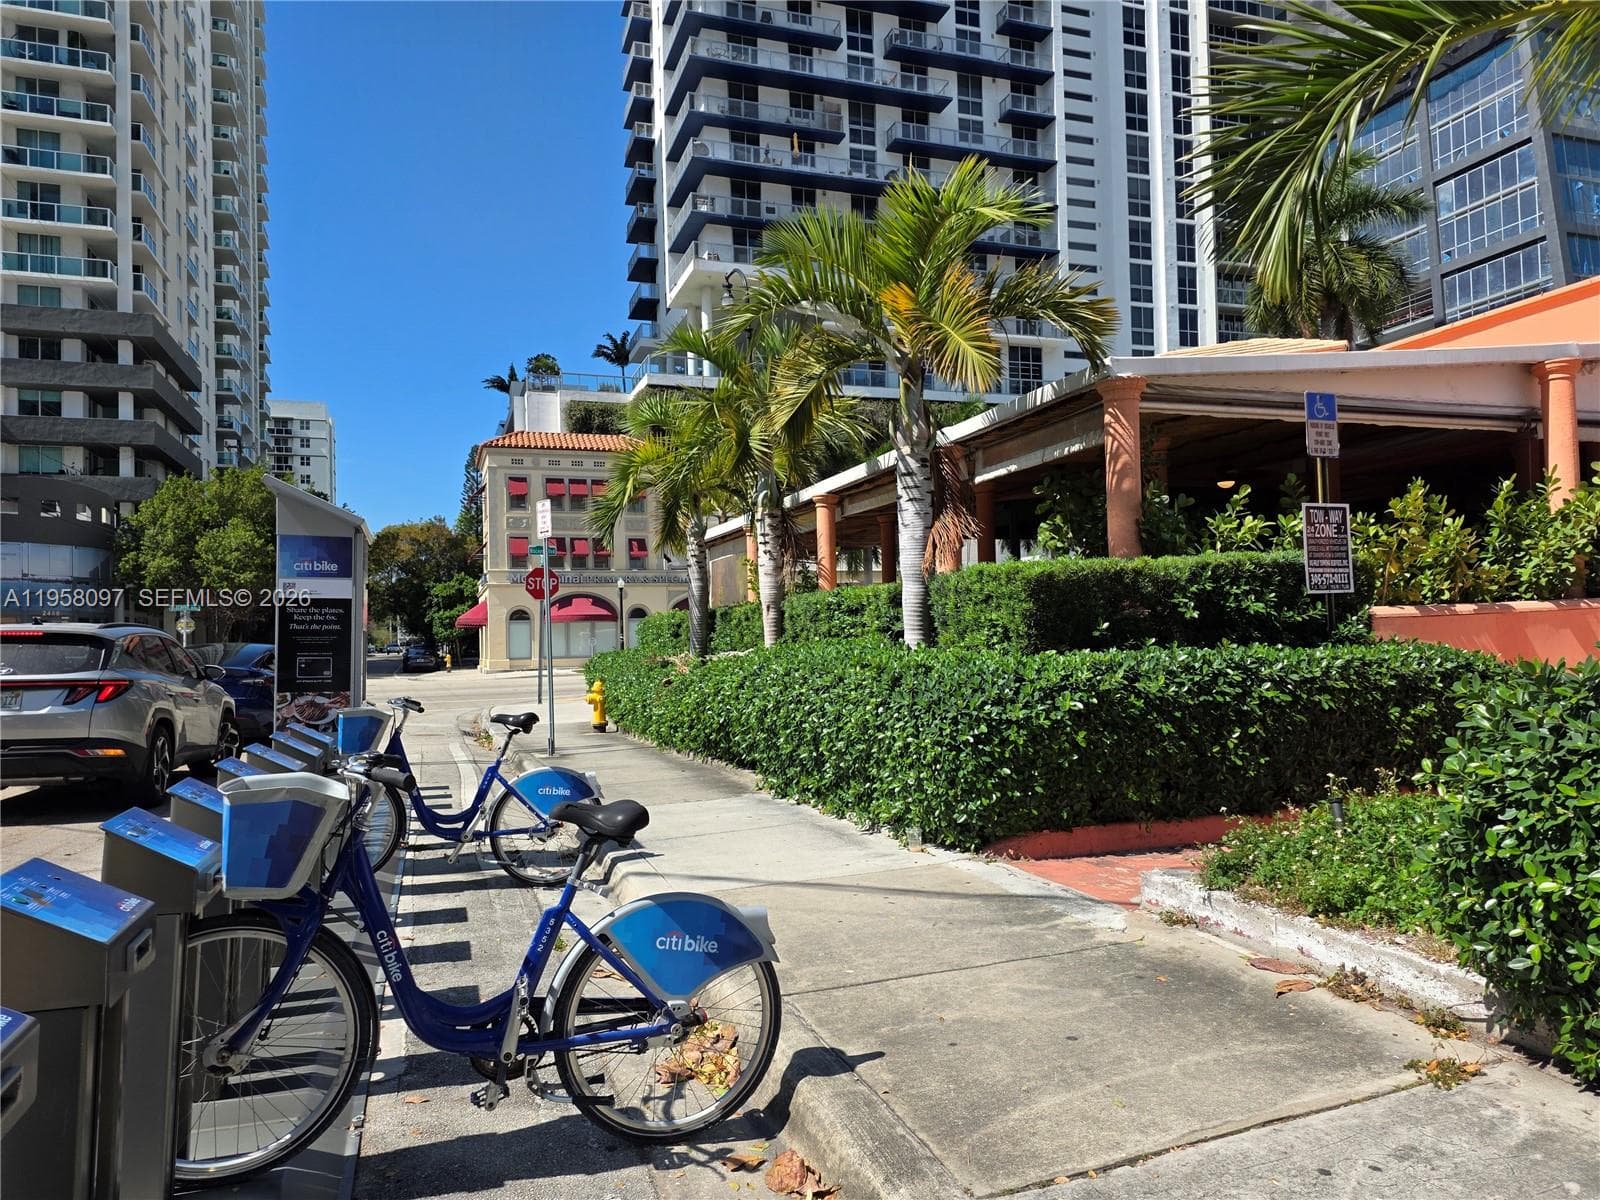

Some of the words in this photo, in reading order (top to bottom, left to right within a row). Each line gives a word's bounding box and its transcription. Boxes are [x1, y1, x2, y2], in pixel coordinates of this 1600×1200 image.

[1309, 509, 1325, 523] TOW
[1328, 509, 1343, 523] WAY
[1314, 524, 1338, 537] ZONE
[313, 560, 338, 571] bike
[559, 573, 583, 584] inai
[586, 575, 639, 584] PRIMRY
[309, 606, 321, 614] the
[683, 934, 719, 954] bike
[384, 950, 403, 983] bike
